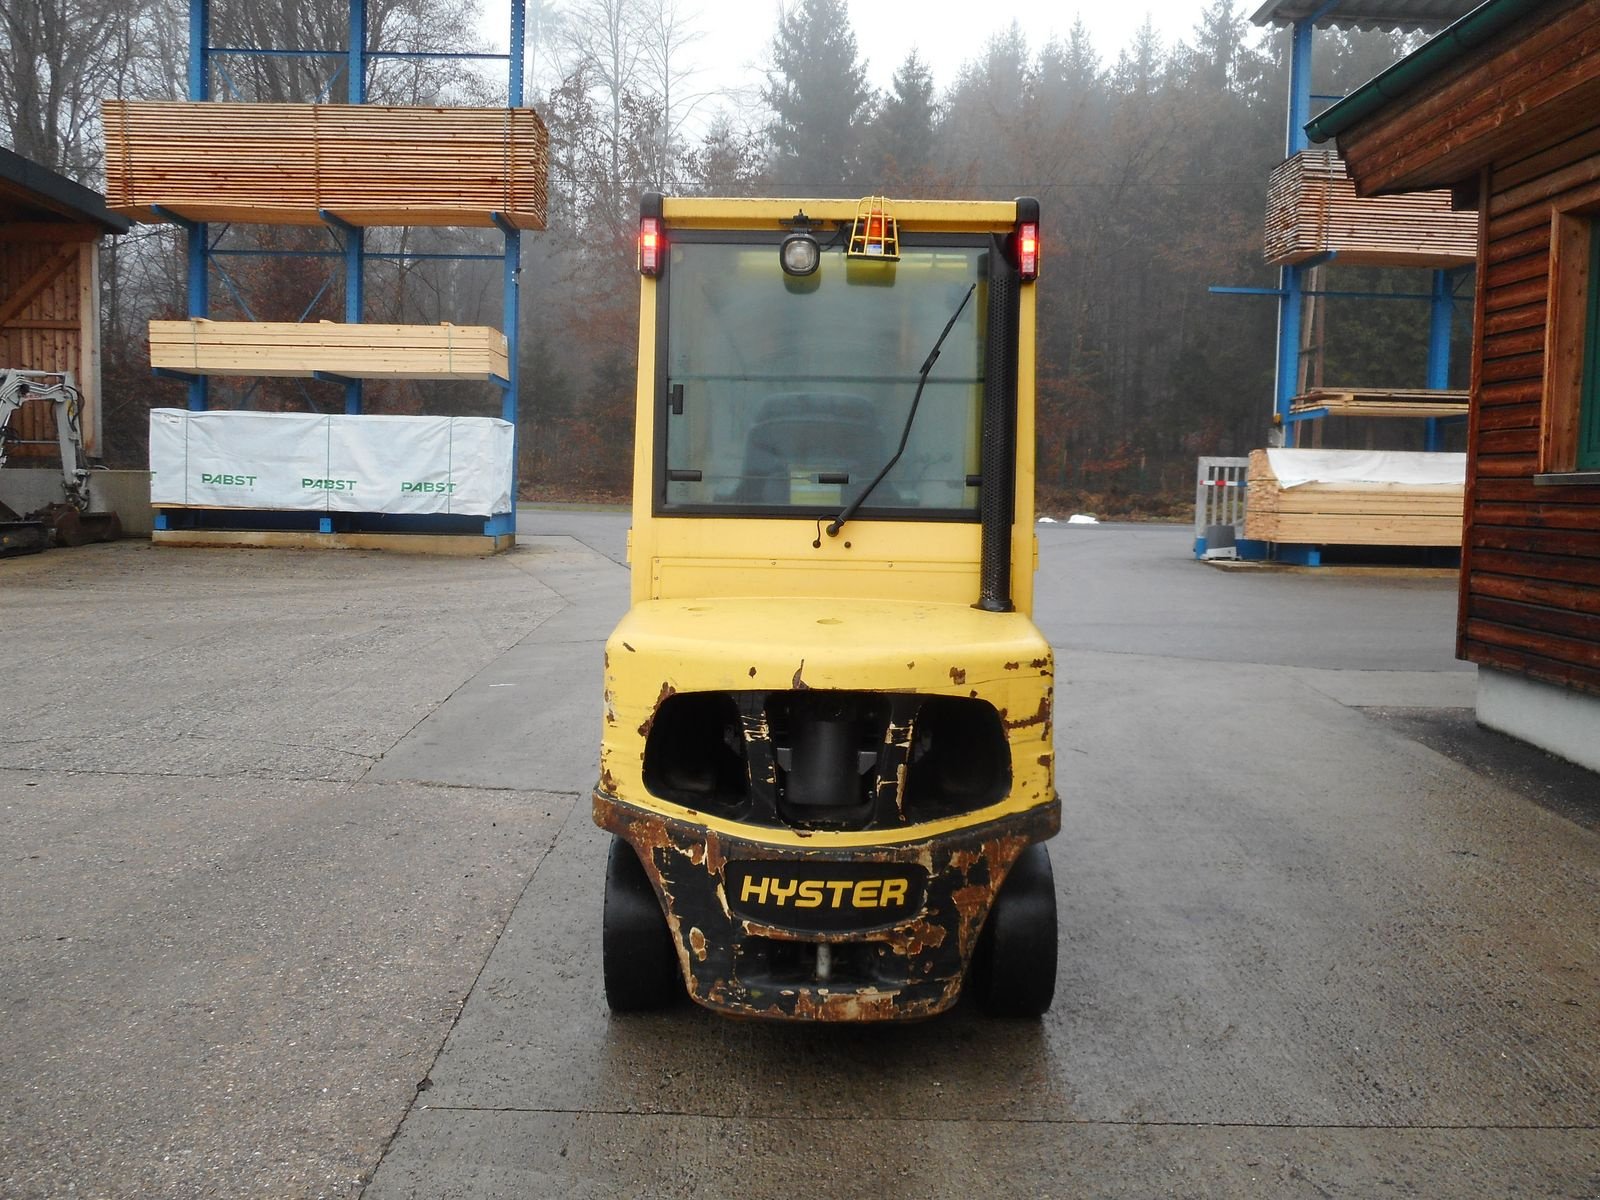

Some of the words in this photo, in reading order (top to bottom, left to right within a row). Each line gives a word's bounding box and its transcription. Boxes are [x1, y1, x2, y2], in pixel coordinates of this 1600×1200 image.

[201, 473, 257, 486] PABST
[302, 478, 357, 490] PABST
[401, 482, 457, 493] PABST
[740, 875, 909, 908] HYSTER
